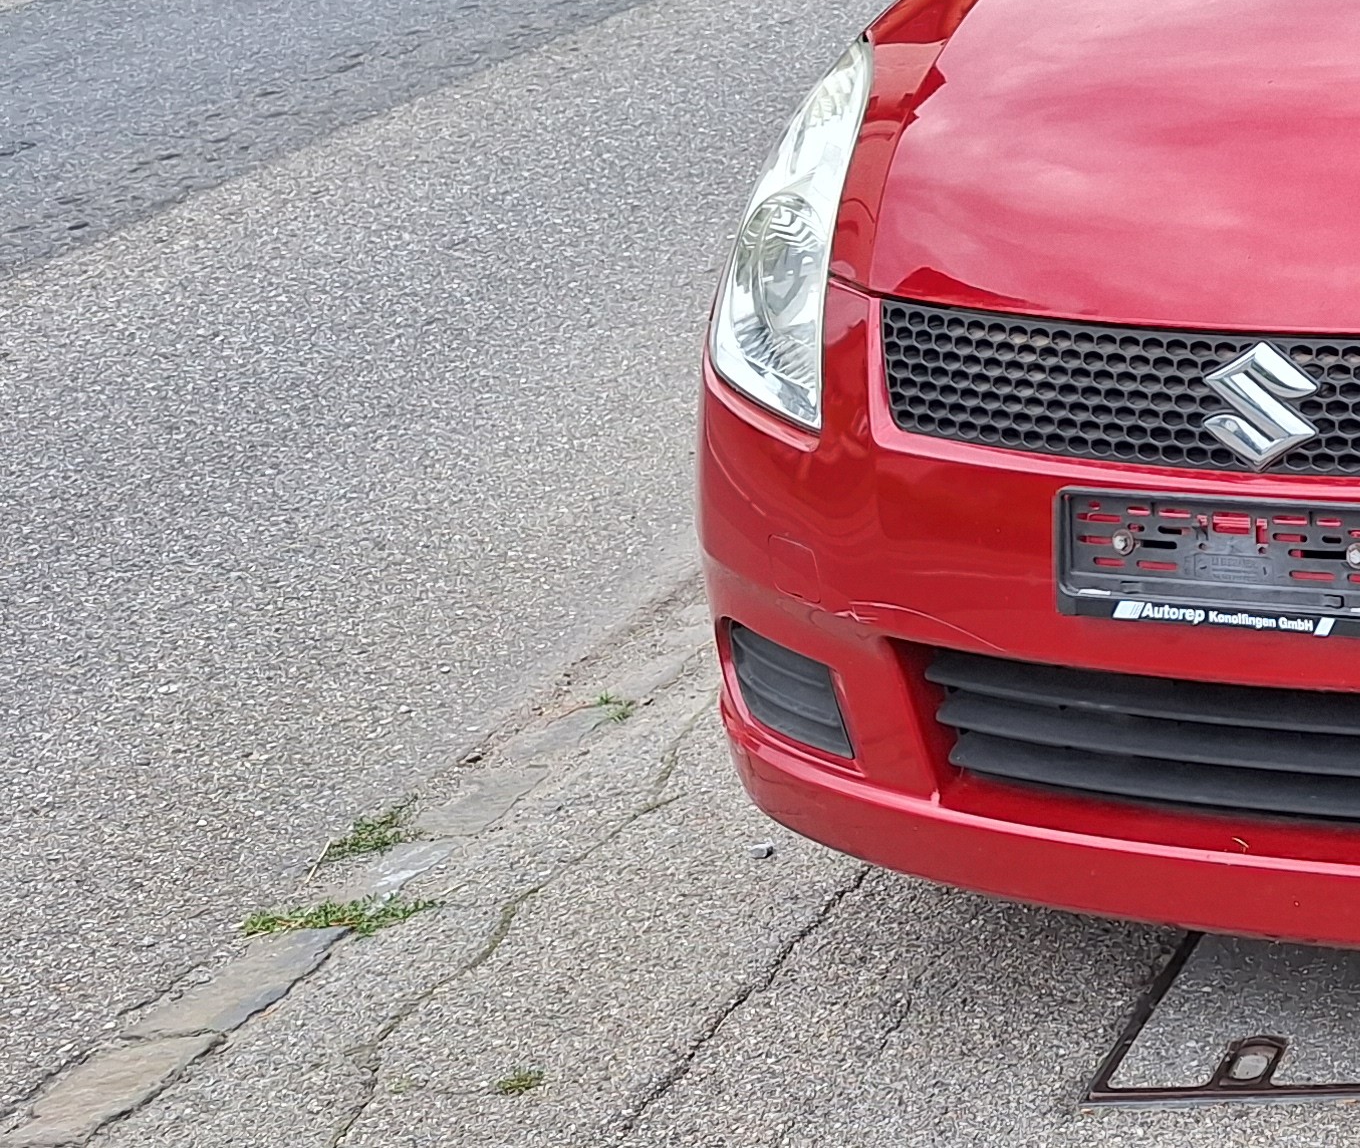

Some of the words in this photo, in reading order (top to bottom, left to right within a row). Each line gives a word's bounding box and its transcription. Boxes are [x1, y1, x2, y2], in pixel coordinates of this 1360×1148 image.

[1141, 602, 1205, 624] Autorep
[1208, 611, 1277, 629] Konolfingen
[1278, 618, 1314, 632] GmbH
